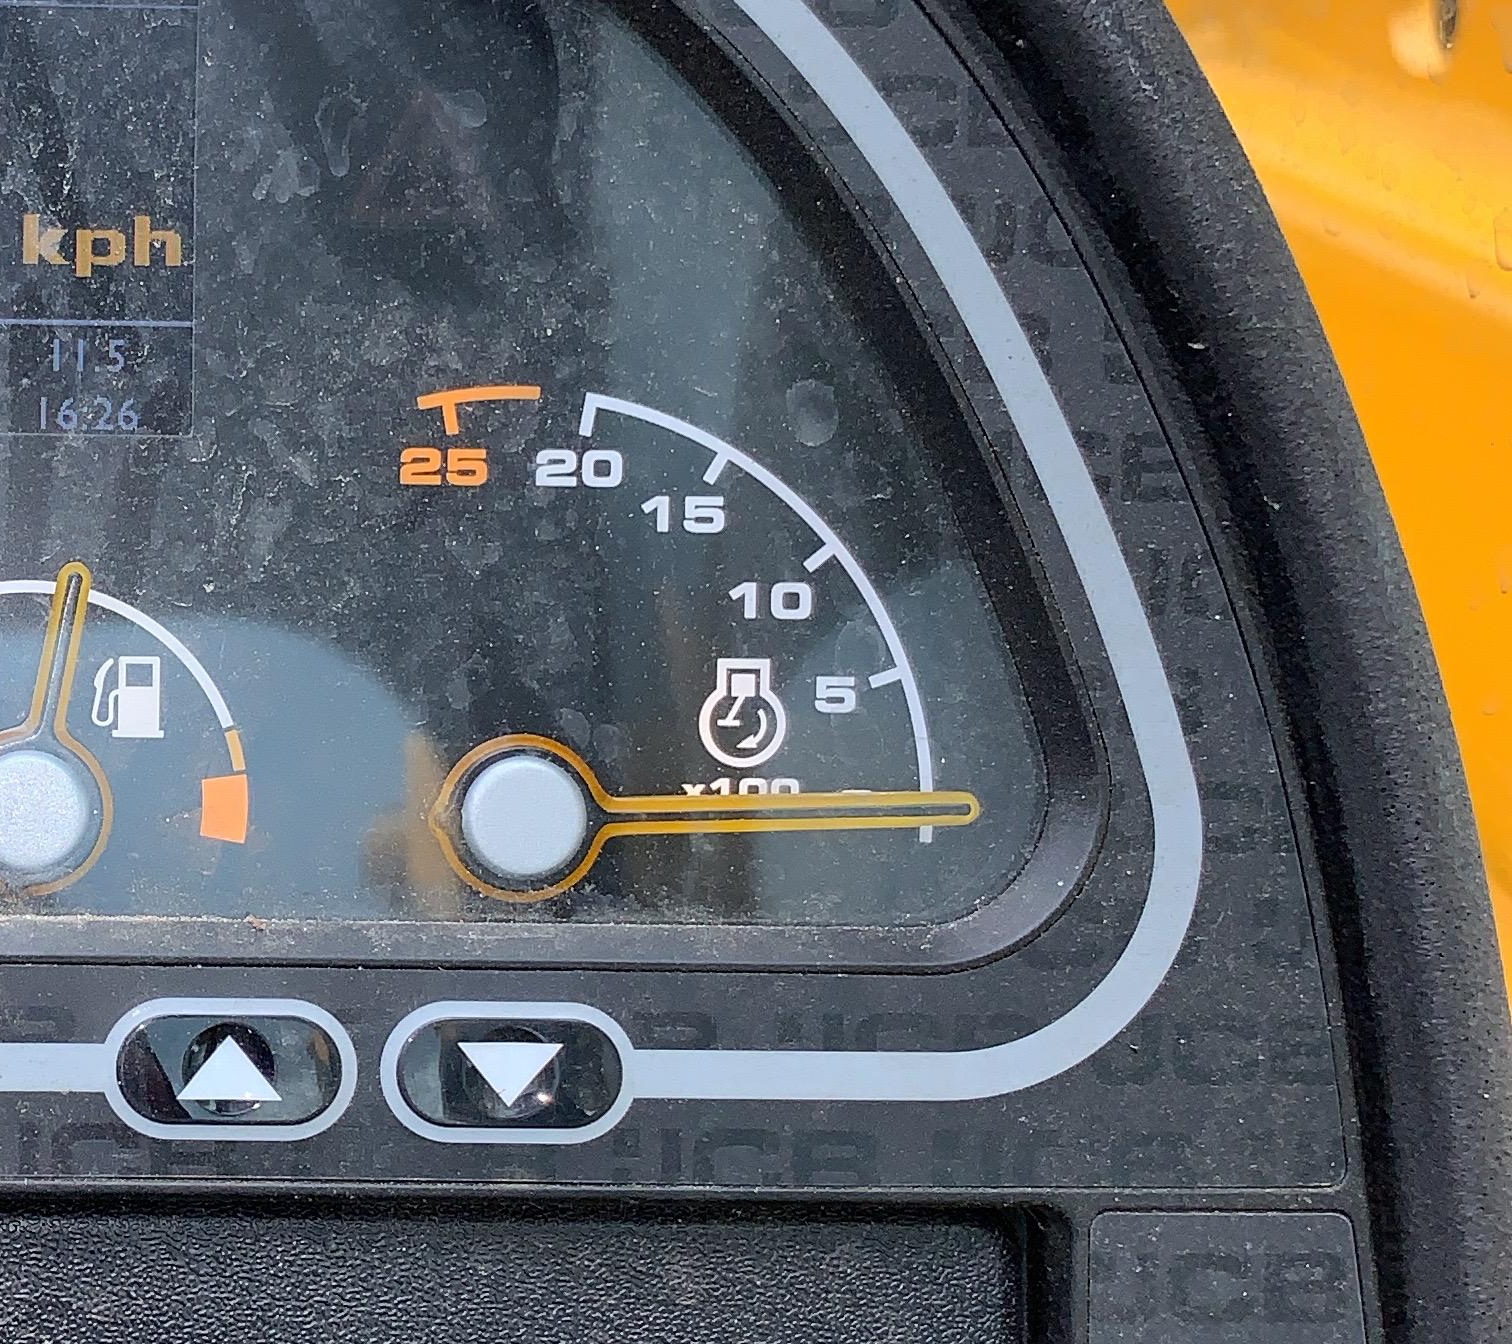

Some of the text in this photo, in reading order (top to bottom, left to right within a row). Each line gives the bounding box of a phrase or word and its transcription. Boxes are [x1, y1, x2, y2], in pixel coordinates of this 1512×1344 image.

[22, 212, 184, 279] kph
[400, 447, 489, 486] 25
[535, 449, 624, 488] 20
[641, 495, 725, 534] 15
[728, 581, 813, 620] 10
[814, 676, 857, 714] 5
